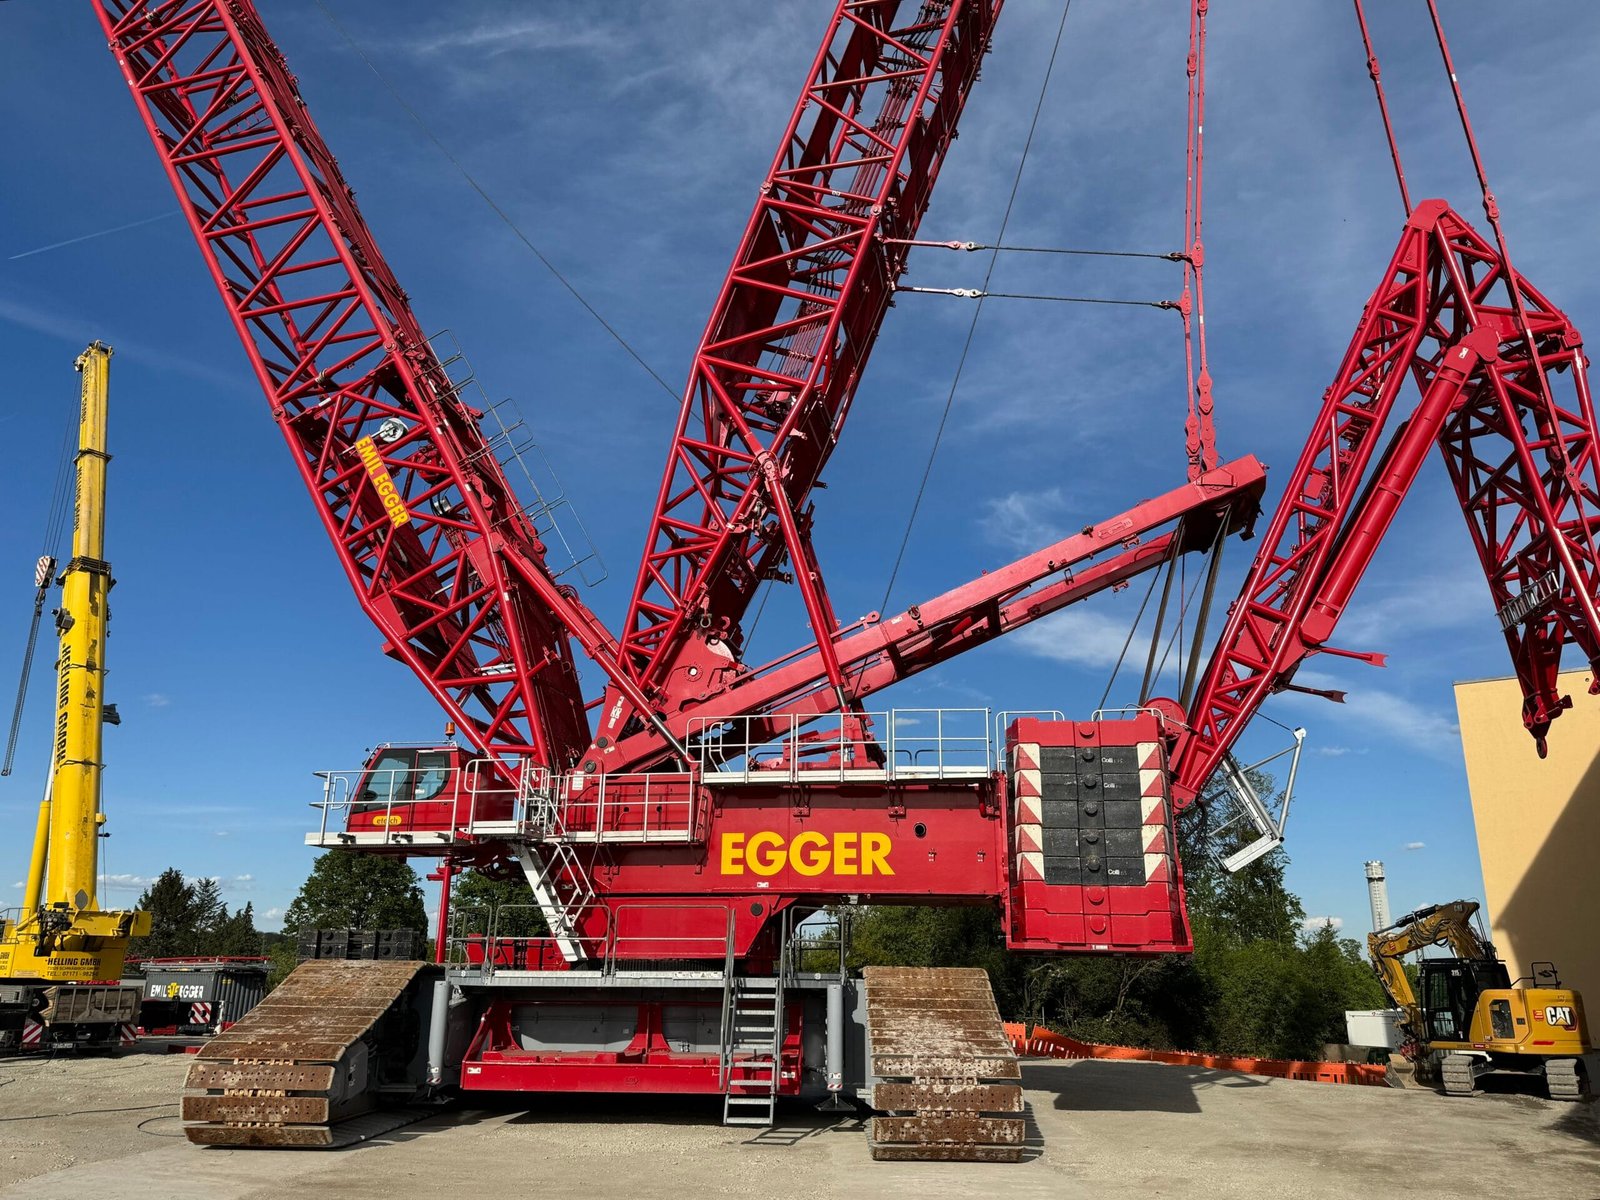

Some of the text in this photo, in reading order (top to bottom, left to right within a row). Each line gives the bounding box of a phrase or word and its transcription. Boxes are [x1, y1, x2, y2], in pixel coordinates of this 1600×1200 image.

[355, 436, 408, 528] EMIL EGGER
[721, 831, 896, 876] EGGER
[47, 958, 102, 967] HELLING GMBH
[150, 984, 204, 999] EMIL EGGER
[1545, 1006, 1572, 1026] CAT
